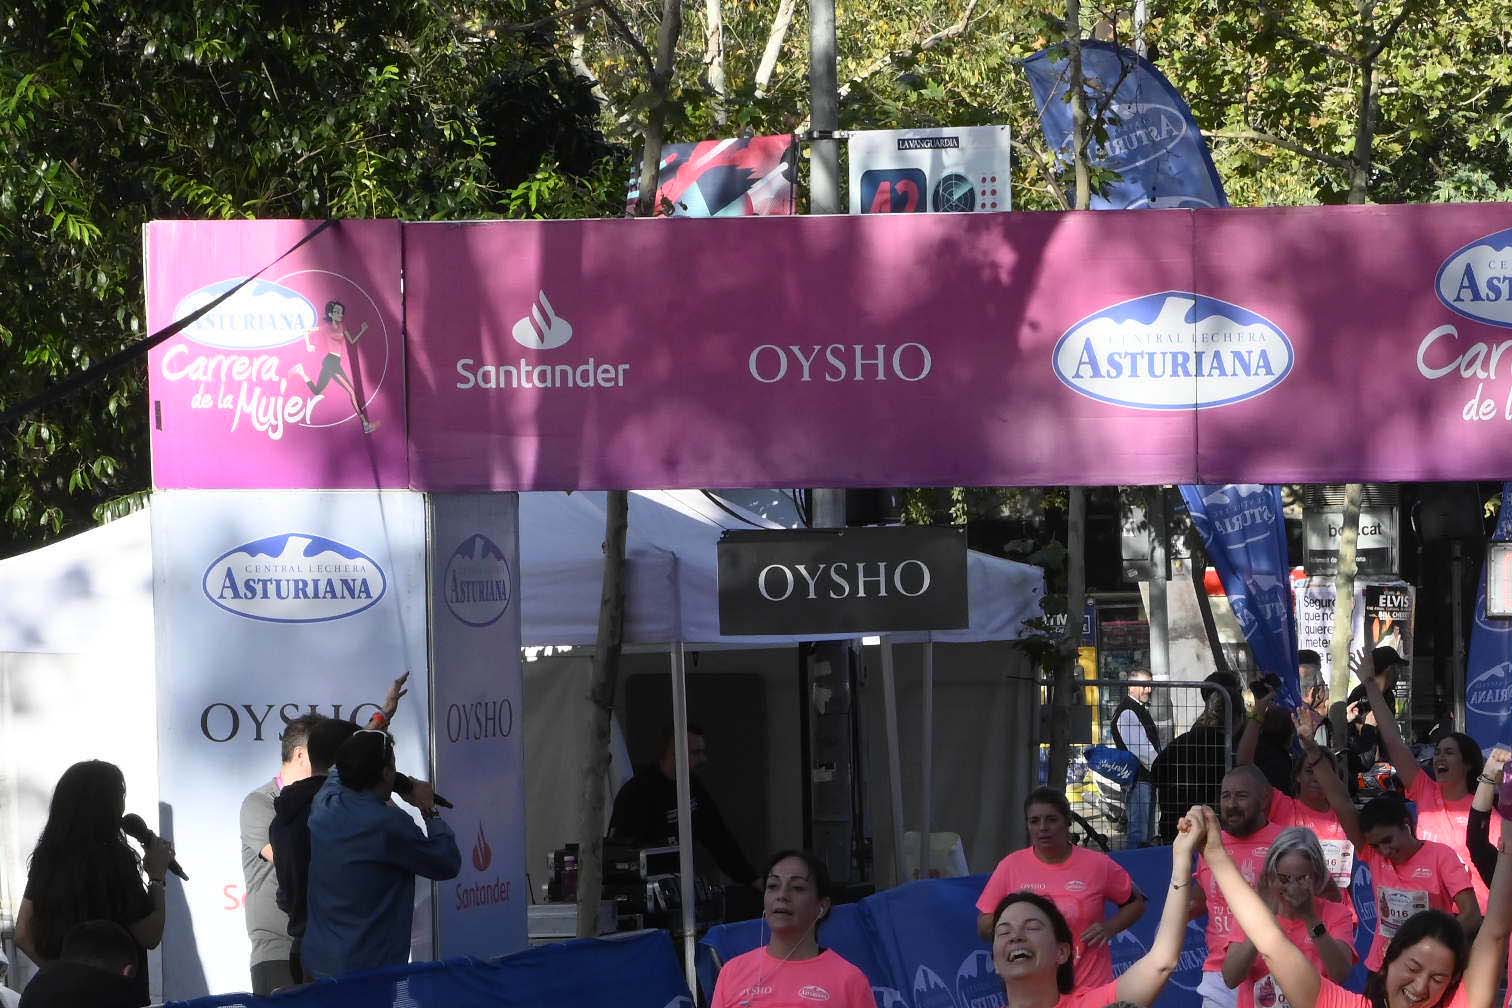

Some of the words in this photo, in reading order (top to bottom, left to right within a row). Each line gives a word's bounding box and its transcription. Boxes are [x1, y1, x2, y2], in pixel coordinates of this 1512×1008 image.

[910, 138, 959, 148] VANGUARDIA
[1107, 331, 1184, 345] CENTRAL
[1192, 331, 1267, 344] LECHERA
[161, 344, 280, 382] Carrera
[456, 358, 630, 389] Santander
[749, 342, 932, 384] OYSHO
[1072, 337, 1276, 380] ASTURIANA
[191, 384, 213, 409] de
[218, 382, 234, 410] la
[231, 379, 325, 440] Mujer
[1462, 383, 1497, 423] de
[217, 566, 374, 601] ASTURIANA
[245, 564, 302, 573] CENTRAL
[308, 563, 367, 573] LECHERA
[758, 559, 931, 602] OYSHO
[451, 570, 506, 605] ASTURIANA
[1380, 595, 1409, 608] ELVIS
[1304, 612, 1321, 624] que
[446, 699, 513, 743] OYSHO
[455, 878, 512, 911] Santander
[1390, 909, 1409, 918] 016
